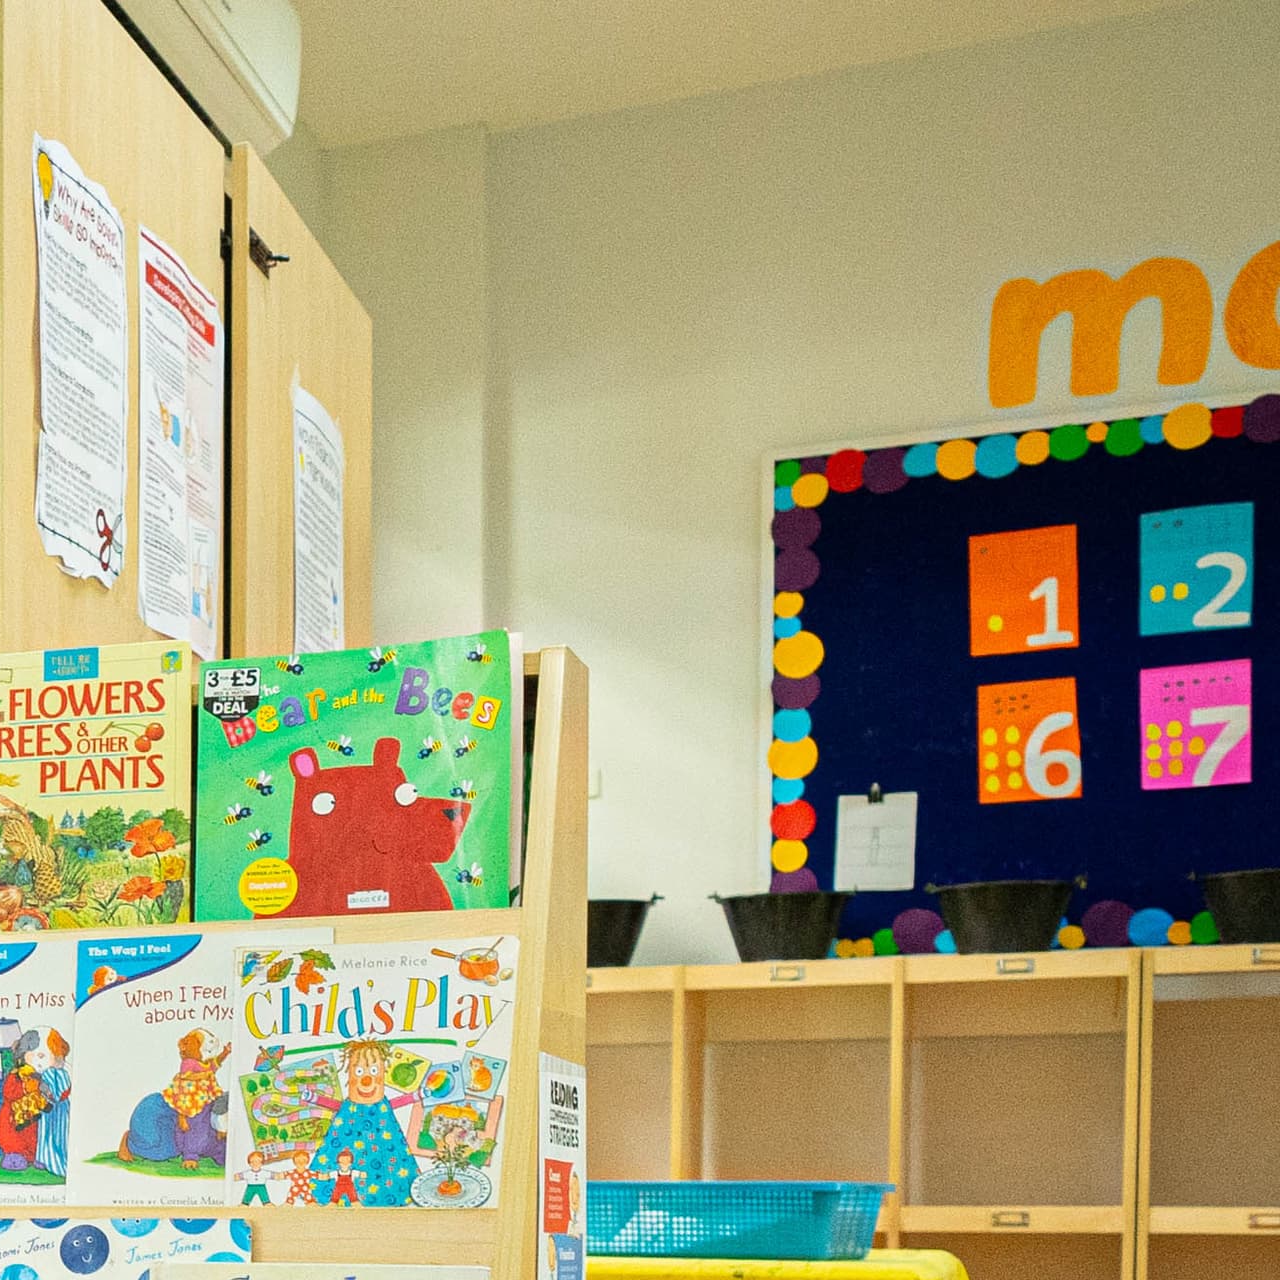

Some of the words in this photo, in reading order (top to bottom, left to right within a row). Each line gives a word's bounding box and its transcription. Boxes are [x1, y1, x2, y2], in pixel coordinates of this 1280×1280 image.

[1192, 551, 1252, 628] 2
[1026, 577, 1075, 647] 1
[207, 670, 220, 688] 3
[230, 668, 258, 687] £5
[9, 678, 167, 722] FLOWERS
[212, 701, 249, 715] DEAL
[332, 689, 359, 711] and
[362, 686, 386, 706] the
[393, 667, 500, 730] Bees
[76, 721, 89, 737] &
[76, 736, 129, 755] OTHER
[1024, 711, 1083, 799] 6
[1189, 705, 1251, 788] 7
[39, 754, 167, 794] PLANTS
[88, 946, 108, 957] The
[110, 945, 136, 957] Way
[144, 943, 171, 954] Feel
[341, 954, 396, 969] Melanie
[399, 953, 429, 968] Rice
[15, 994, 22, 1010] I
[28, 991, 65, 1009] Miss
[124, 989, 174, 1008] When
[179, 986, 187, 1003] I
[192, 985, 227, 1001] Feel
[144, 1007, 196, 1025] about
[245, 978, 395, 1042] Child's
[402, 975, 510, 1044] Play
[26, 1236, 56, 1254] Jones
[125, 1246, 163, 1264] James
[168, 1240, 203, 1256] Jones
